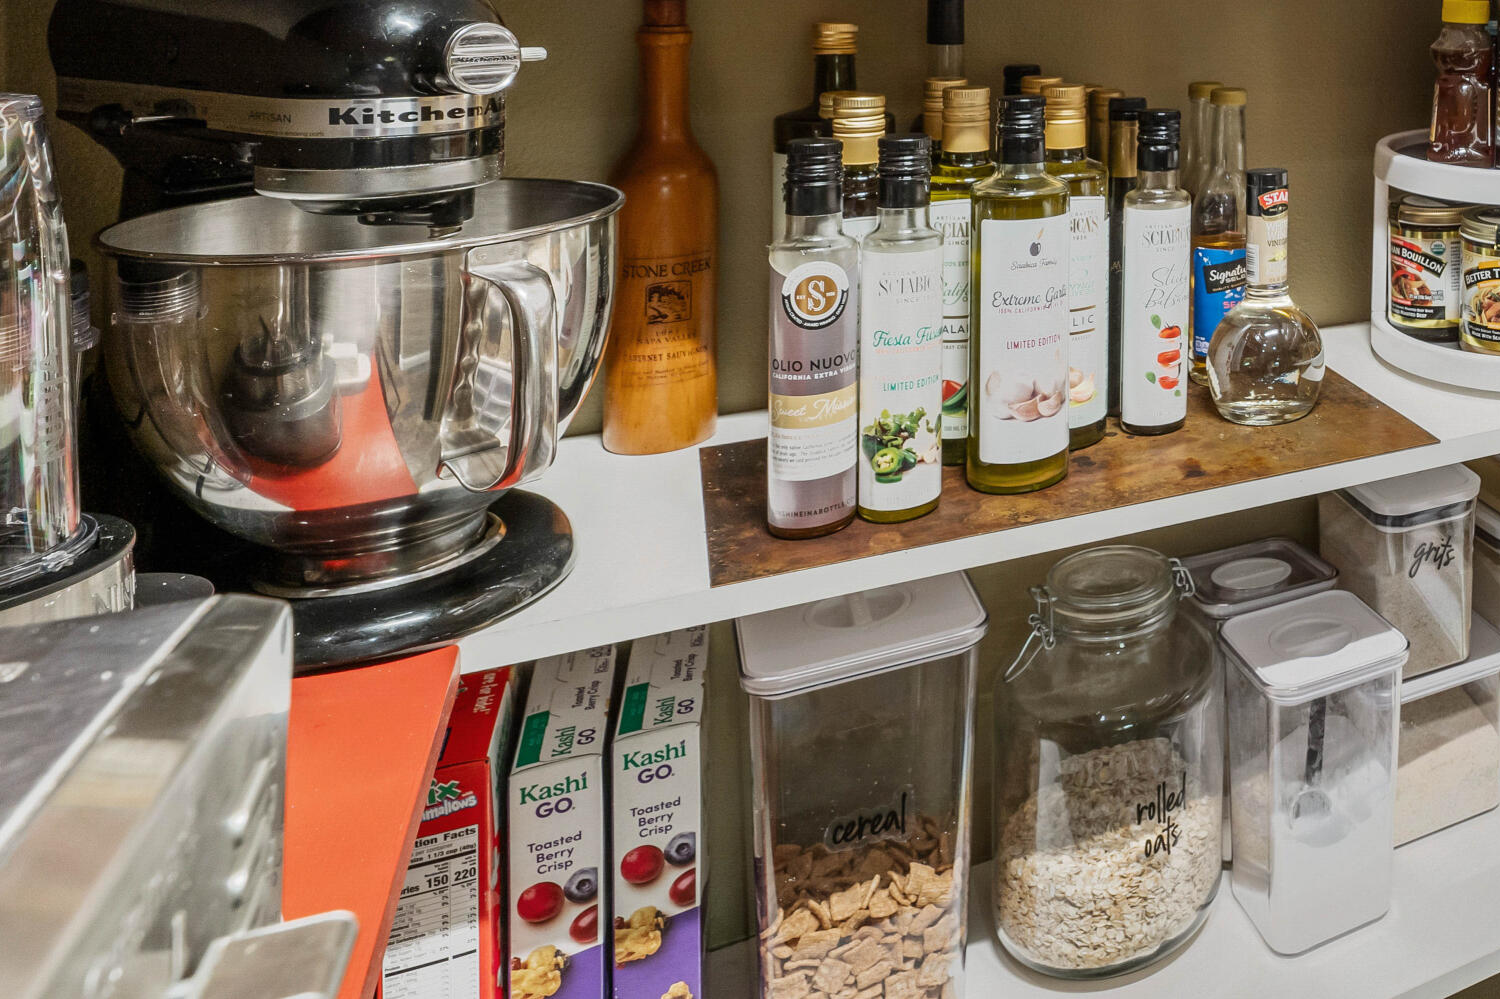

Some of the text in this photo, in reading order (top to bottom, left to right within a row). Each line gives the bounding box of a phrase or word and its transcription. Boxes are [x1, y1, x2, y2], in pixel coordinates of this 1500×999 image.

[248, 112, 291, 124] ARTISAN
[1401, 248, 1443, 273] BOUILLON
[622, 263, 668, 279] STONE
[1465, 269, 1491, 284] BETTER
[992, 290, 1041, 308] Extreme
[1006, 333, 1062, 350] LIMITED EDITION
[772, 359, 803, 373] OLIO
[772, 370, 838, 382] CALIFORNIA EXTRA
[883, 374, 940, 393] LIMITED EDITION
[1409, 539, 1455, 578] grits
[653, 696, 695, 727] Kashi GO
[622, 740, 687, 770] Kashi
[637, 764, 673, 784] GO
[519, 772, 588, 805] Kashi
[535, 797, 574, 819] GO
[629, 796, 682, 818] Toasted
[1136, 773, 1187, 825] rolled
[637, 812, 674, 829] Berry
[832, 792, 907, 847] cereal
[443, 826, 477, 842] Facts
[639, 822, 674, 839] Crisp
[1143, 820, 1182, 860] oats
[527, 830, 582, 854] Toasted
[536, 847, 575, 865] Berry
[537, 858, 574, 876] Crisp
[426, 867, 477, 889] 150 220
